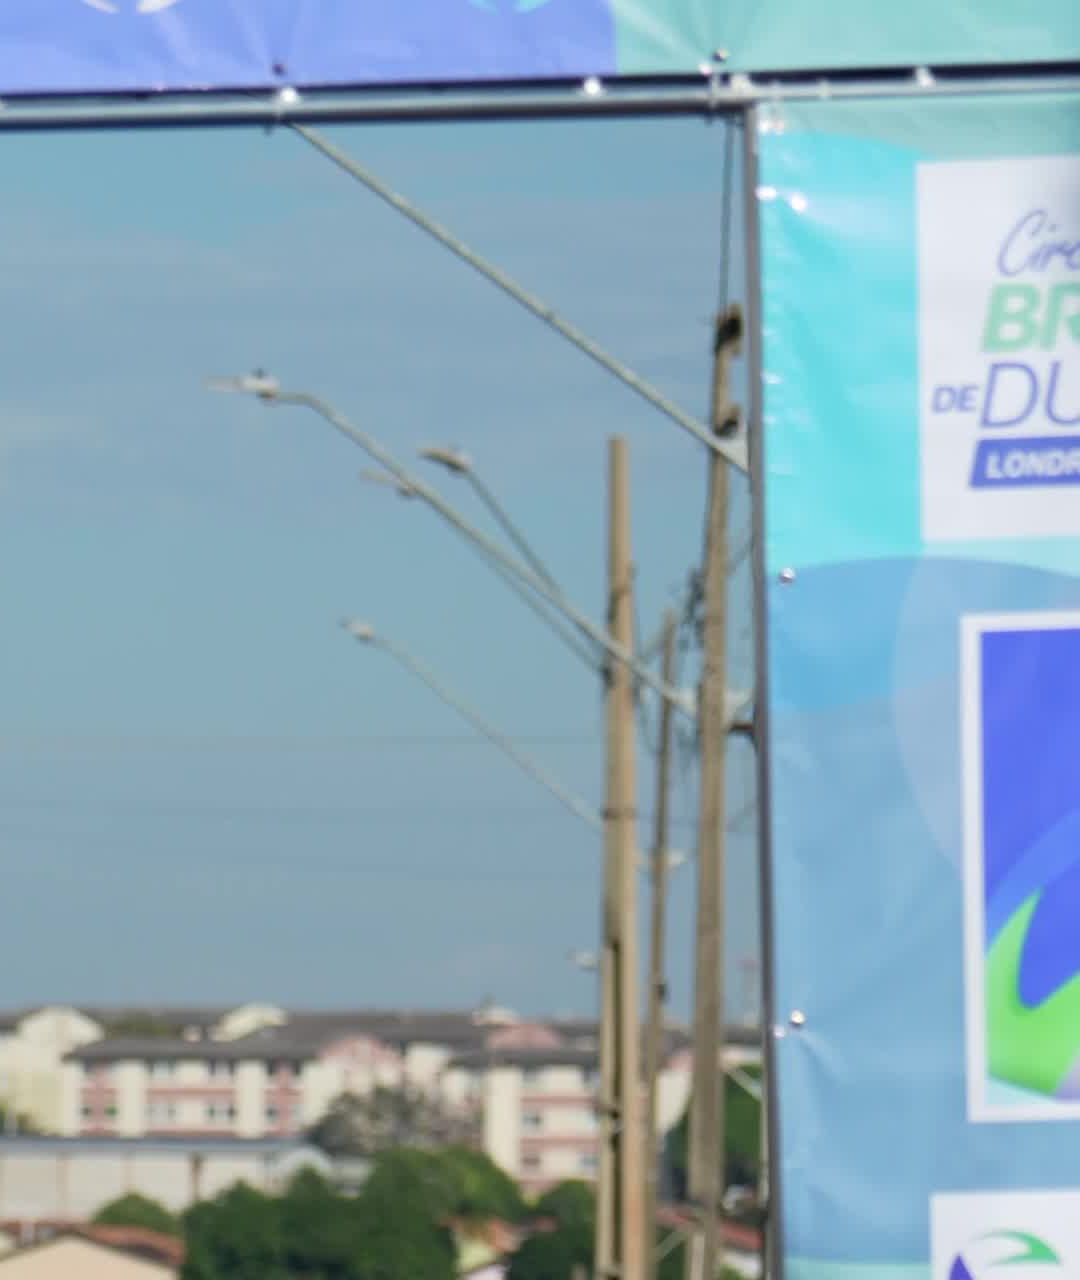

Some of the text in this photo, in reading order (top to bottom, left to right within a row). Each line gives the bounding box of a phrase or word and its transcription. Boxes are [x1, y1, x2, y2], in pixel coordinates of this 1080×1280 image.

[982, 283, 1080, 351] BR
[932, 361, 1080, 428] DE DU
